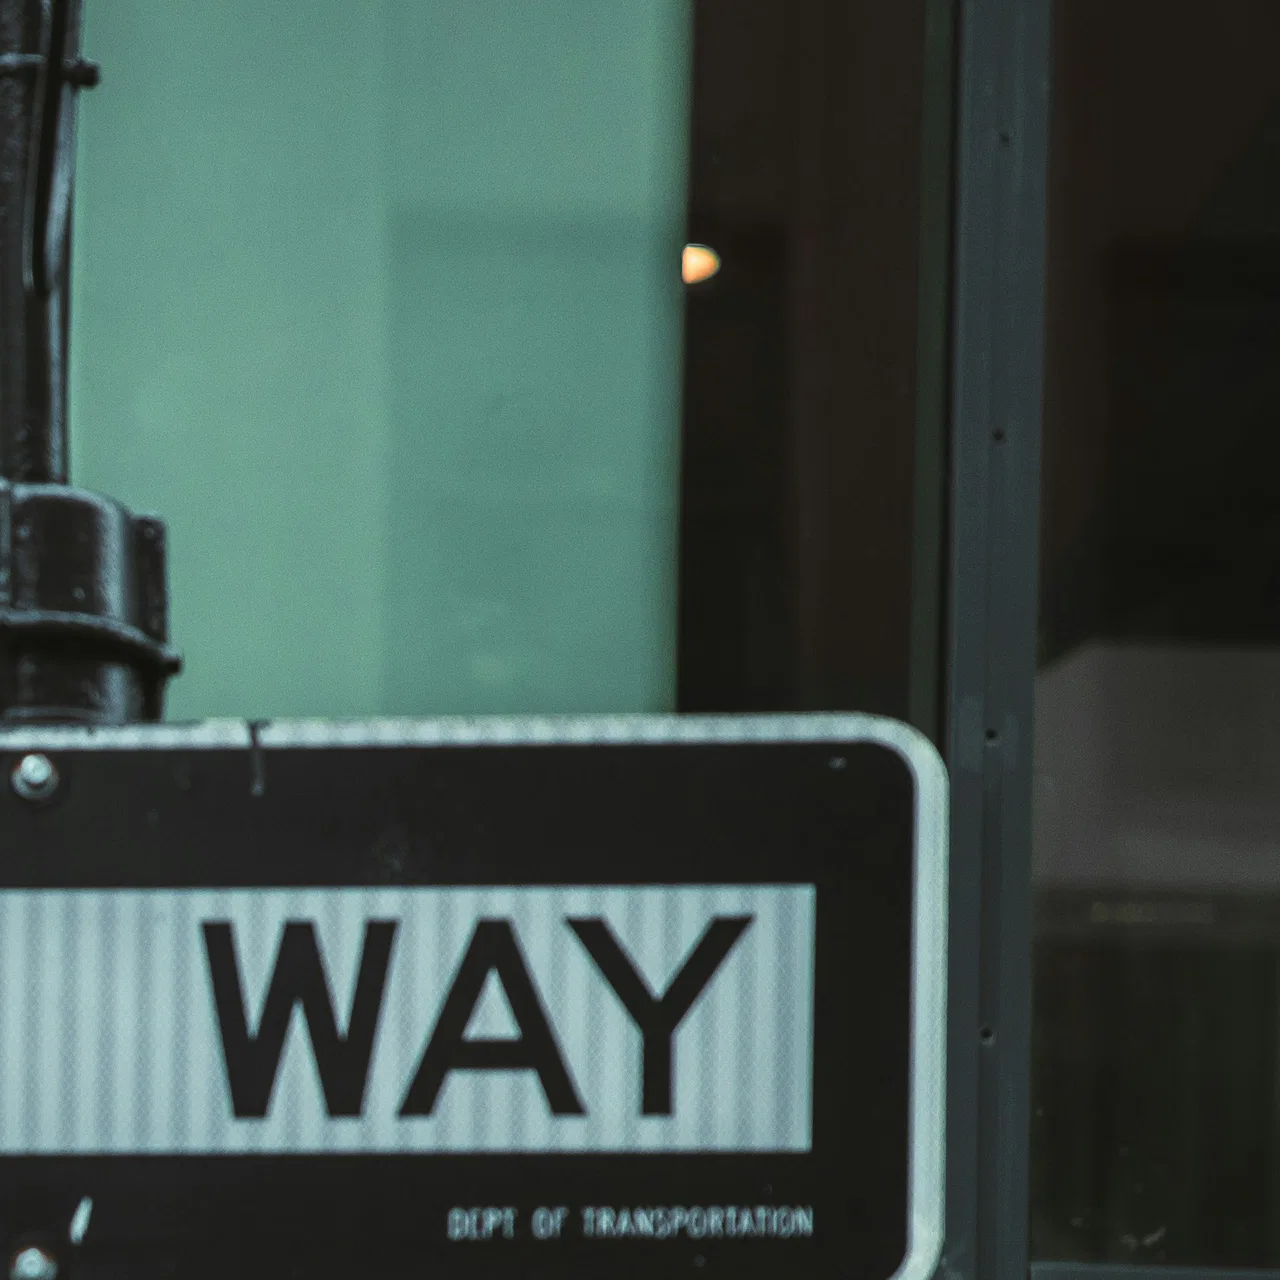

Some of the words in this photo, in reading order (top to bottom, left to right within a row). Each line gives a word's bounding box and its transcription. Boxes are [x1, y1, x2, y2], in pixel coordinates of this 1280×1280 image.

[201, 914, 755, 1121] WAY
[447, 1206, 518, 1240] DEPT
[531, 1206, 568, 1239] OF
[581, 1205, 814, 1239] TRANSPORTATION
